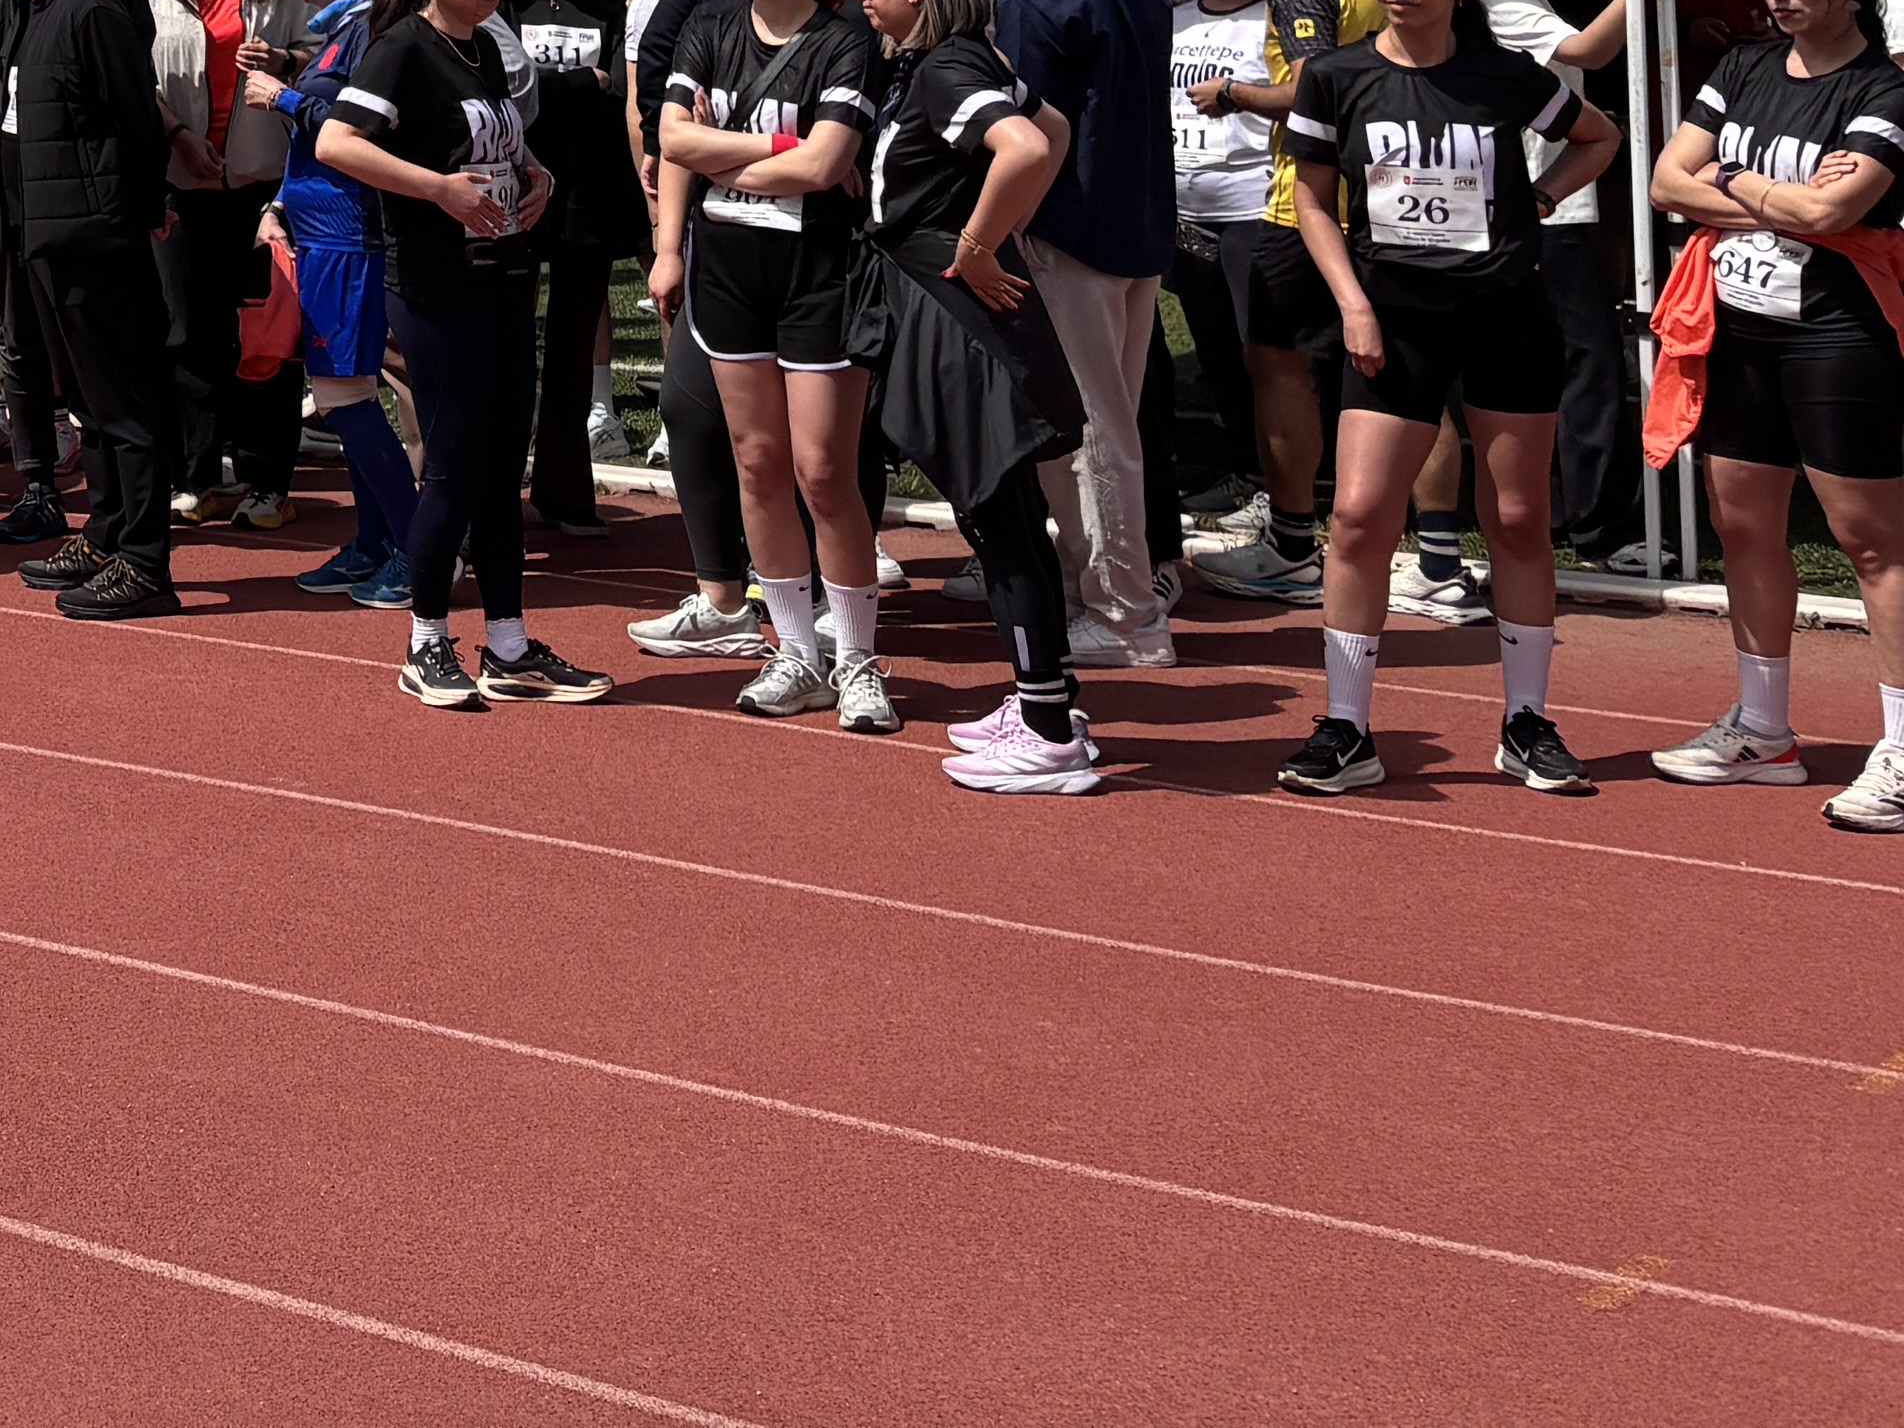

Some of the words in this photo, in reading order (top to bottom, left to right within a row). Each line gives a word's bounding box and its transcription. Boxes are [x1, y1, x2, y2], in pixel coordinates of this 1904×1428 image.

[534, 44, 583, 67] 311
[1397, 194, 1450, 225] 26
[1717, 250, 1778, 289] 647
